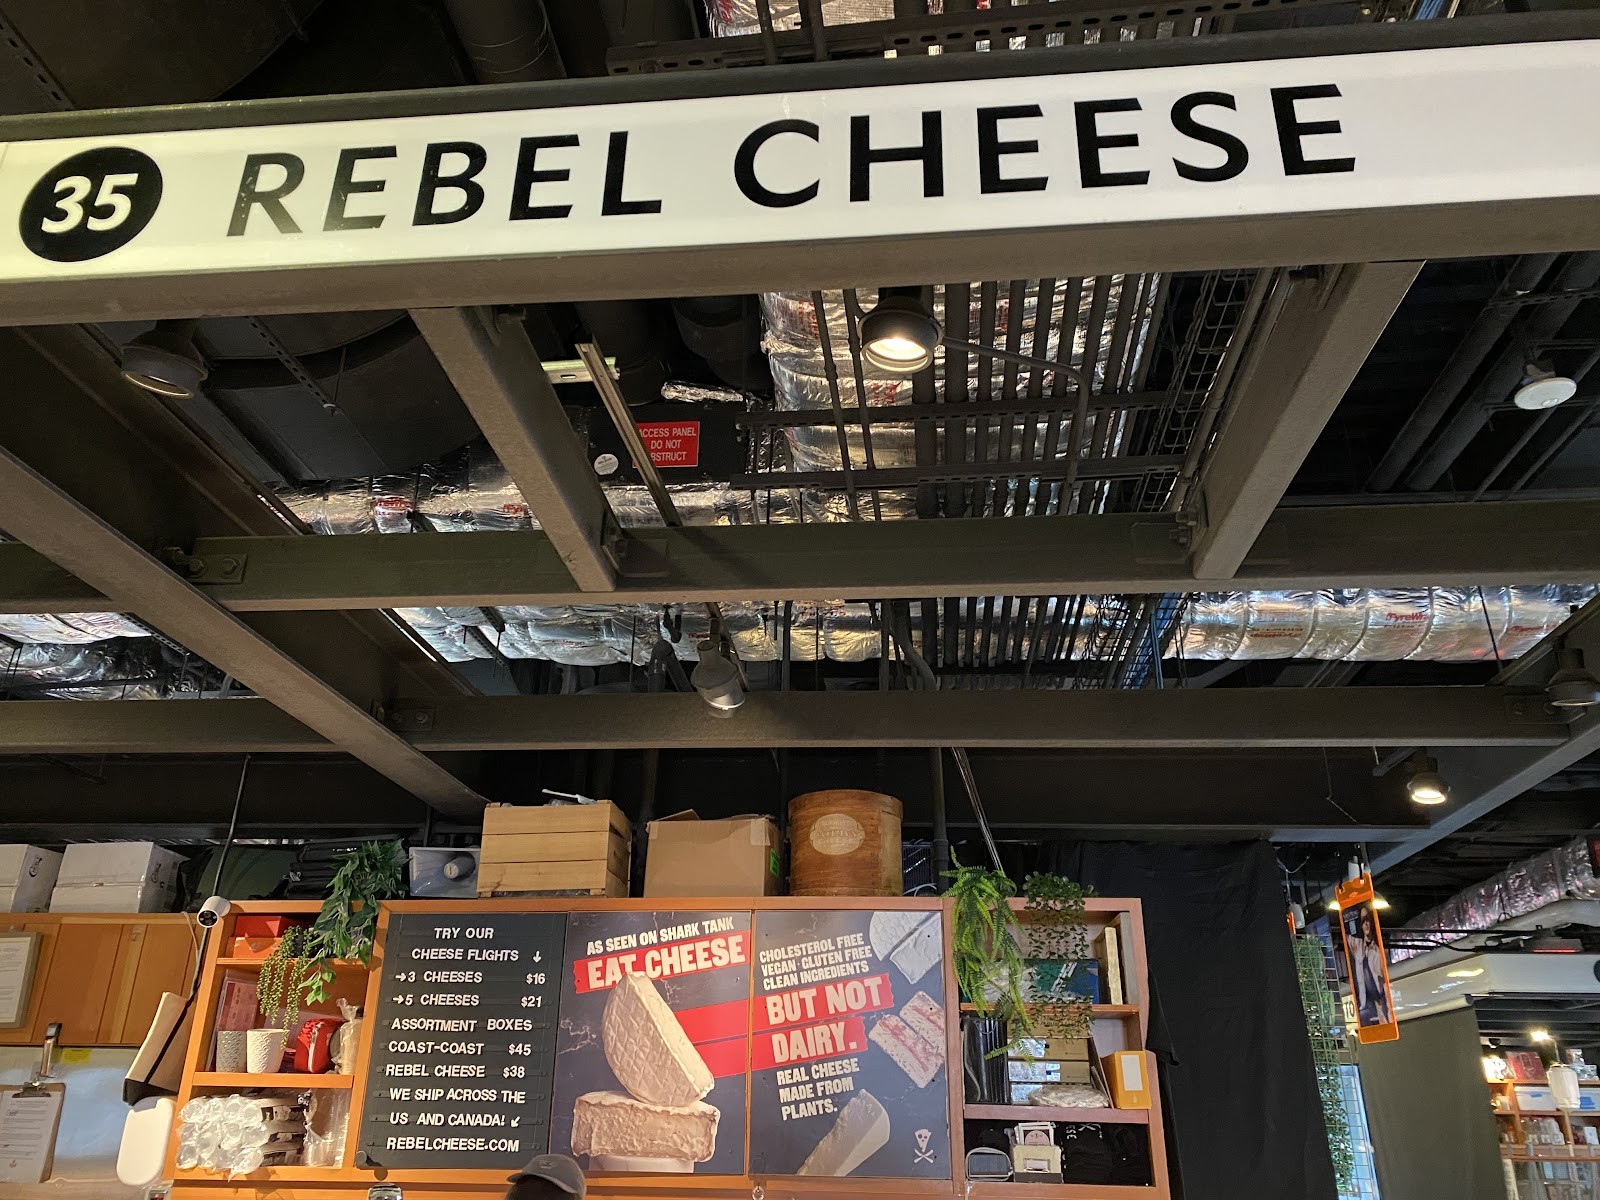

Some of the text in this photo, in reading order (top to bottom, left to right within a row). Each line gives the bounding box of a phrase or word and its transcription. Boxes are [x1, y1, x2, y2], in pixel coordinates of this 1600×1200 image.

[41, 84, 1356, 237] 35 REBEL CHEESE
[672, 428, 696, 436] PANEL
[650, 440, 681, 449] DO NOT
[651, 452, 687, 461] BSTRUCT
[434, 928, 494, 939] TRY OUR
[587, 916, 734, 955] AS SEEN ON SHARK TANK
[412, 948, 519, 961] CHEESE FLIGHTS
[760, 933, 864, 963] CHOLESTEROL FREE
[587, 935, 746, 989] EAT CHEESE
[761, 946, 872, 976] VEGAN GLUTEN FREE
[423, 971, 483, 983] CHEESES
[526, 973, 546, 985] $16
[763, 961, 869, 990] CLEAN INGREDIENTS
[420, 994, 479, 1006] CHEESES
[521, 996, 542, 1008] $21
[766, 977, 882, 1025] BUT NOT
[391, 1018, 532, 1032] ASSORTMENT BOXES
[388, 1042, 532, 1056] COAST-COAST $45
[772, 1022, 858, 1063] DAIRY.
[386, 1064, 525, 1078] REBEL CHEESE $38
[776, 1058, 860, 1085] REAL CHEESE
[390, 1088, 526, 1103] WE SHIP ACROSS THE
[779, 1077, 854, 1103] MADE FROM
[782, 1099, 838, 1121] PLANTS.
[390, 1112, 505, 1126] US AND CANADA!
[387, 1136, 519, 1152] REBELCHEESE.COM
